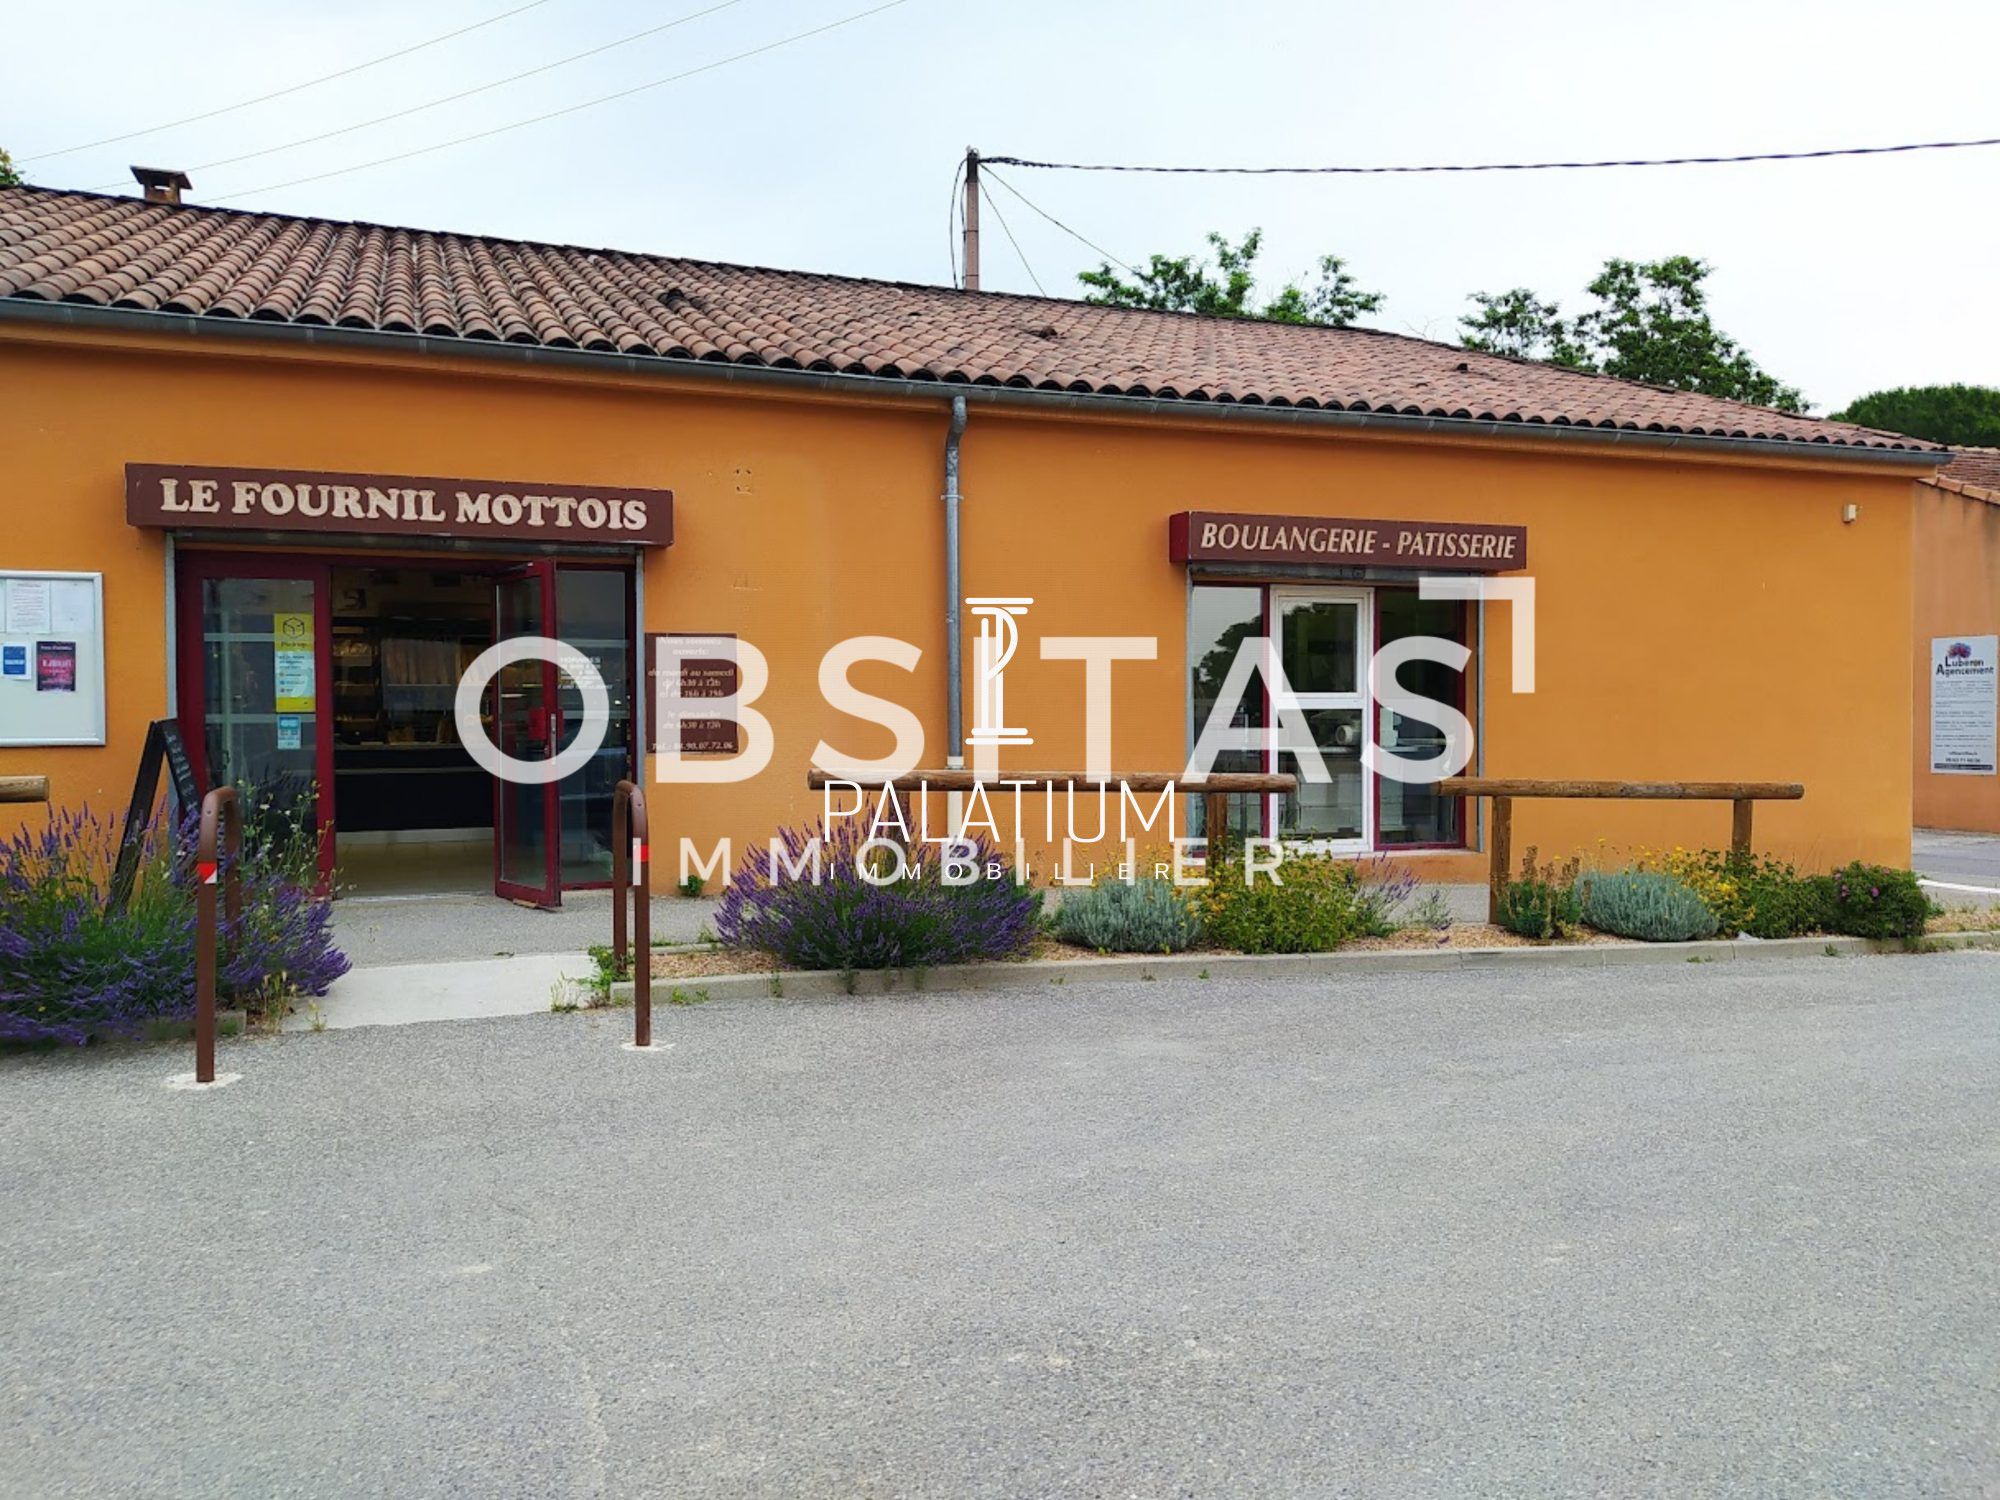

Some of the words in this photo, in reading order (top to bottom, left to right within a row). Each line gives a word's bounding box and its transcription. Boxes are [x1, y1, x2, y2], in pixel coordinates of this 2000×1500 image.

[159, 478, 220, 513] LE
[232, 482, 447, 522] FOURNIL
[455, 491, 648, 530] MOTTOIS
[1201, 522, 1376, 554] BOULANGERIE
[1397, 531, 1517, 559] PATISSERIE
[1936, 663, 1994, 678] Agencement
[1945, 655, 1984, 667] Luberon
